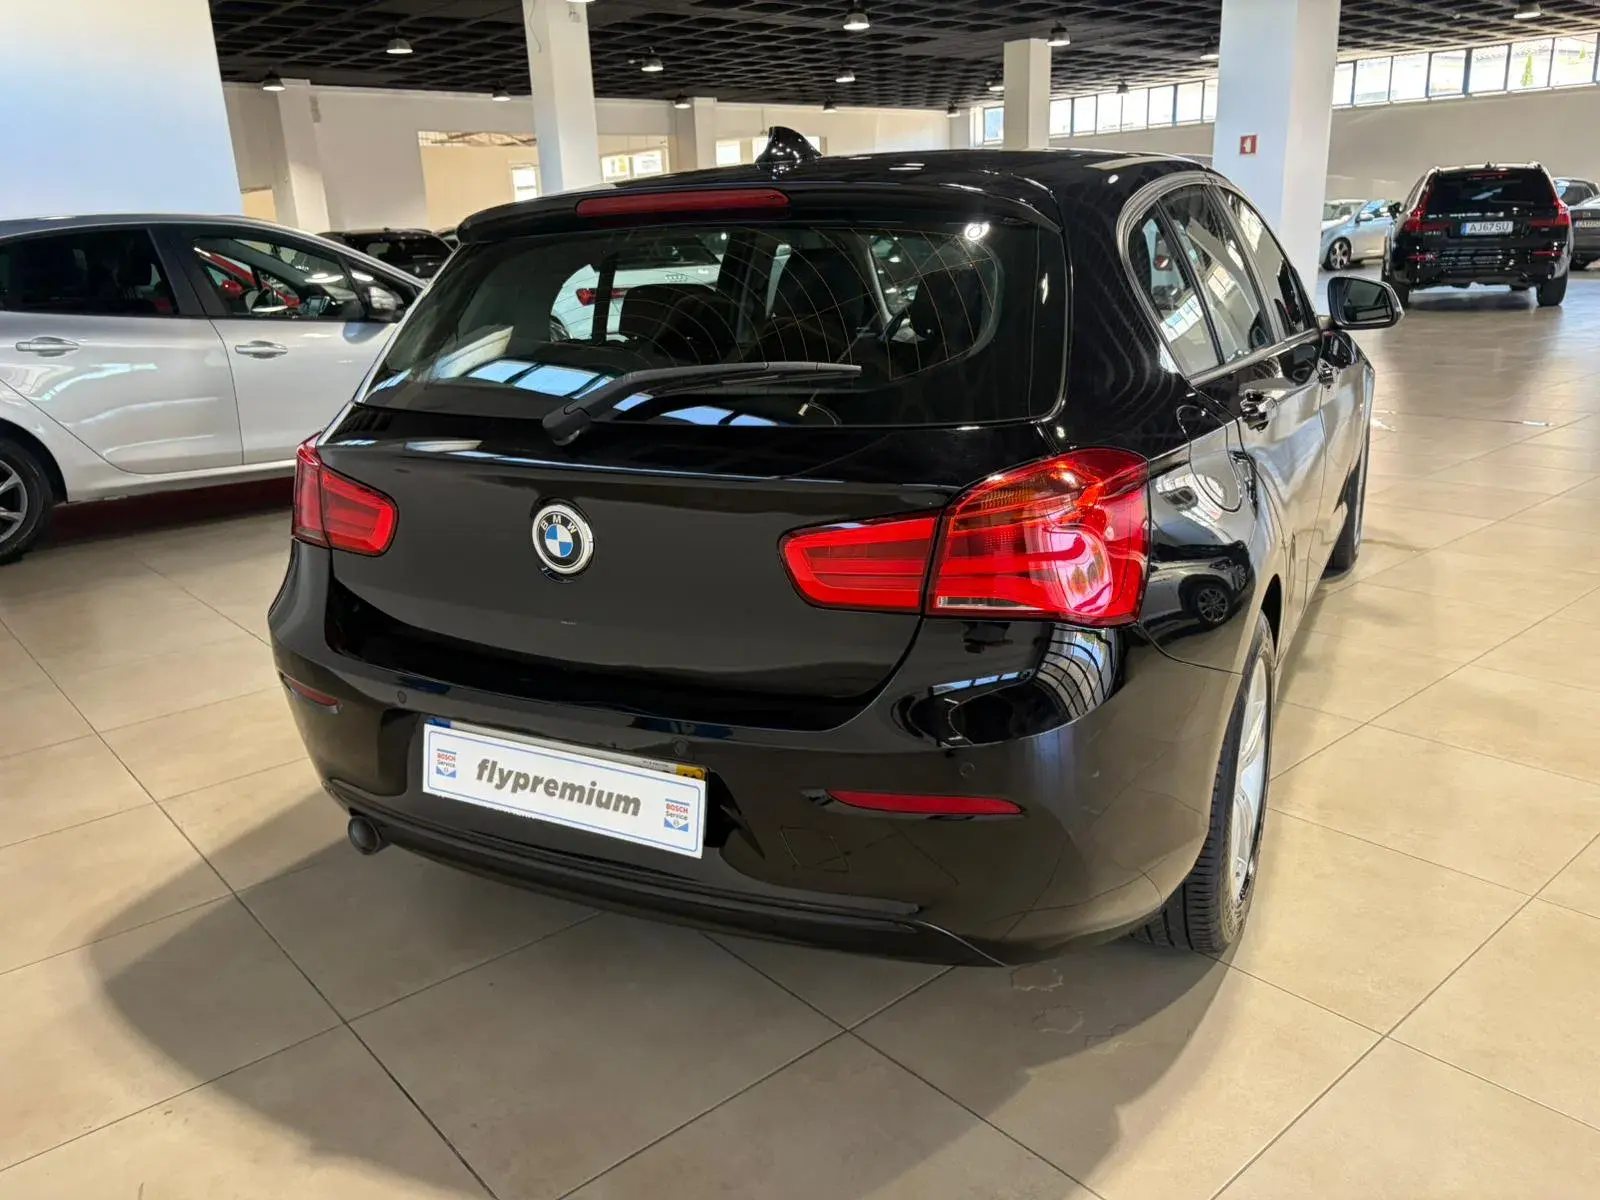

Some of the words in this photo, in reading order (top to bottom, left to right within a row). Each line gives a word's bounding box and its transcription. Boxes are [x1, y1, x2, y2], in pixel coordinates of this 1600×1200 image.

[540, 514, 577, 534] BMW
[437, 752, 456, 762] BOSCH
[437, 760, 456, 769] Service
[476, 758, 642, 817] flypremium
[666, 803, 689, 814] BOSCH
[666, 811, 689, 821] Service
